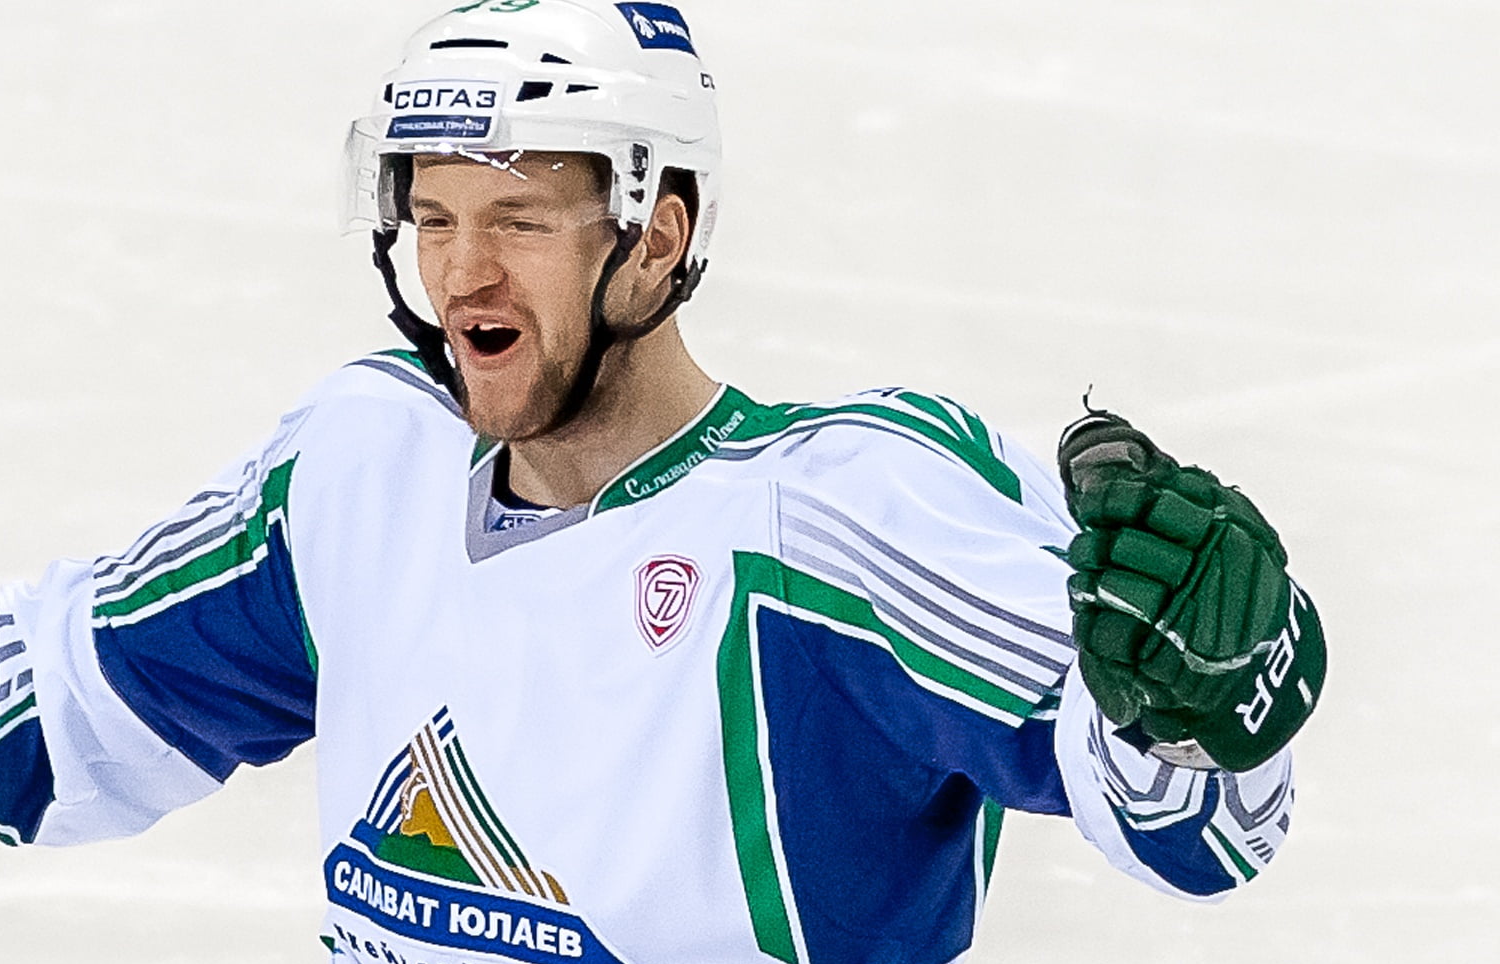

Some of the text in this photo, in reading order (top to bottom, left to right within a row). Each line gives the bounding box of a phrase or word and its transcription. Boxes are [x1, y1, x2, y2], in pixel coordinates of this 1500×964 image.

[395, 89, 497, 109] СОГАЗ
[334, 861, 583, 958] САЛАВАТ ЮЛАЕВ
